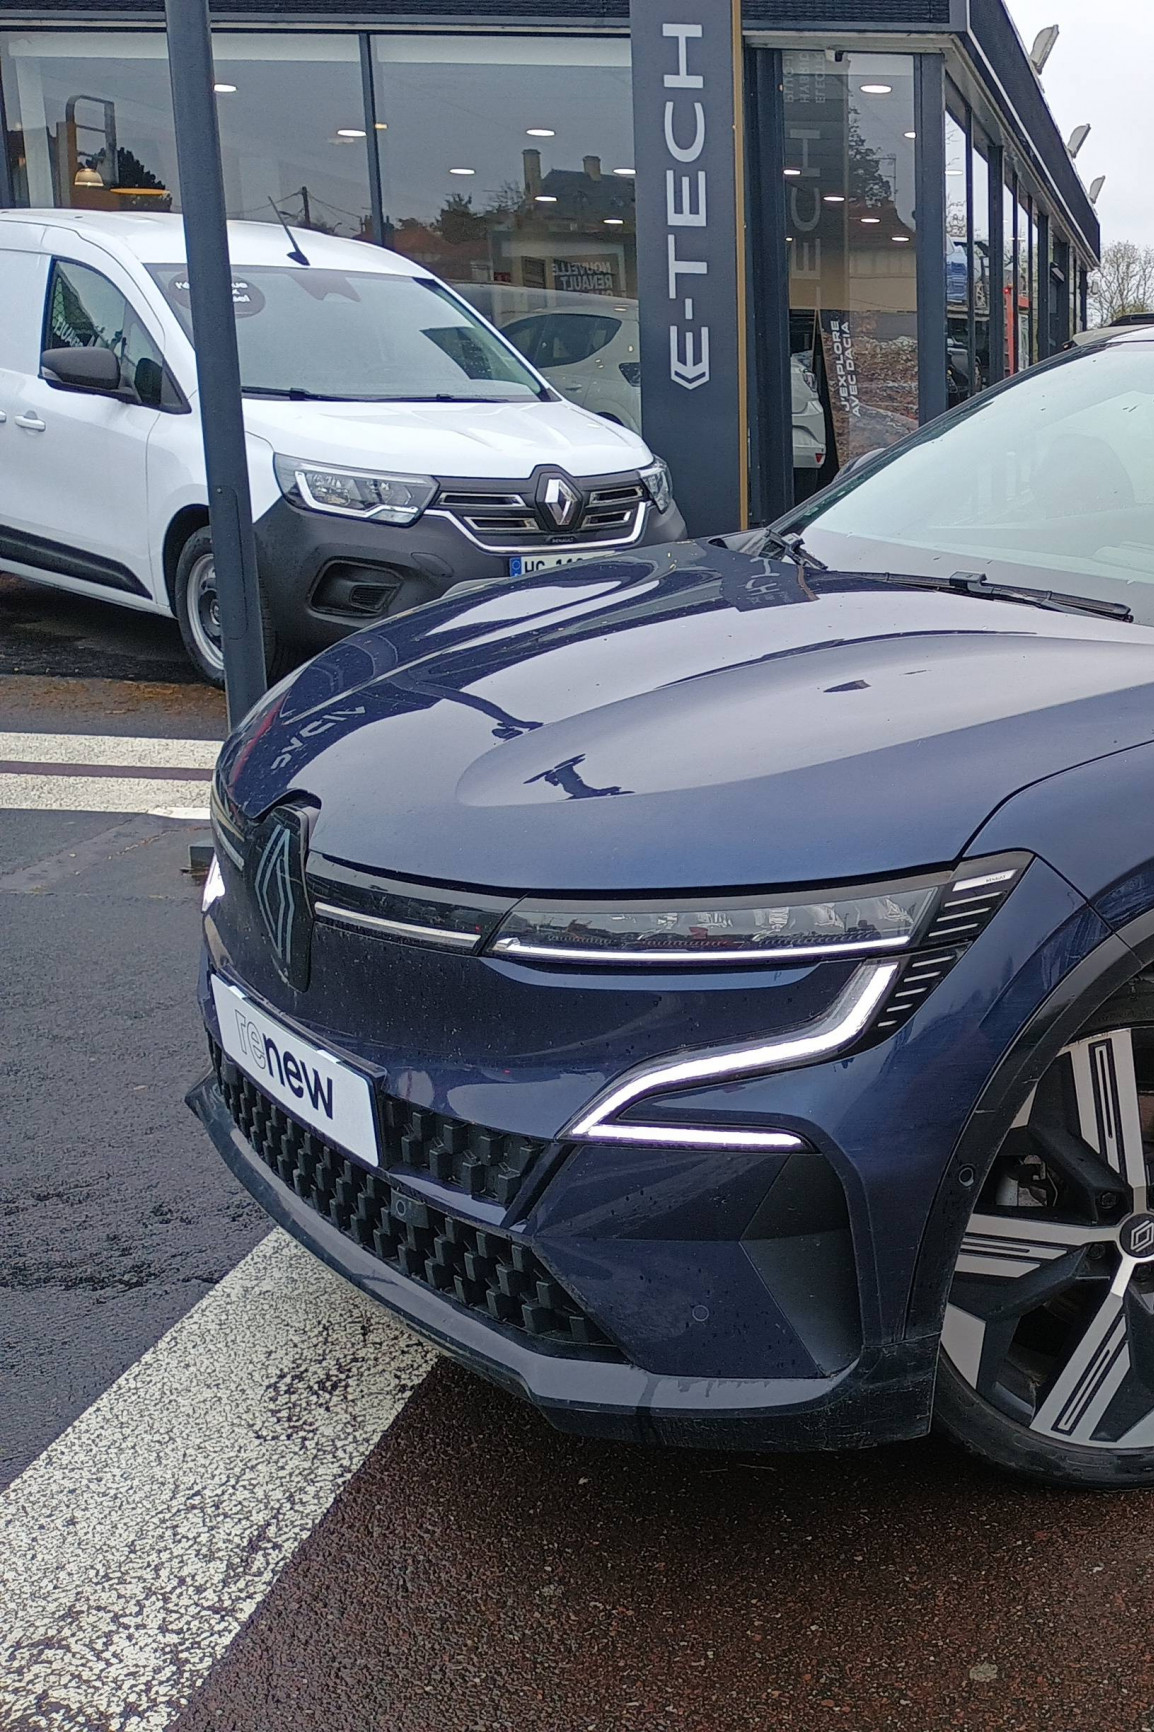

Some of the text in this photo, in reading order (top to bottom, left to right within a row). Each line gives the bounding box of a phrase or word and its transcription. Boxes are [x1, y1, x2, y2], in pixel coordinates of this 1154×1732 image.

[662, 23, 710, 390] E-TECH
[830, 320, 850, 412] J'EXPLORE
[841, 321, 861, 417] AVEC DACIA
[234, 1009, 333, 1120] renew
